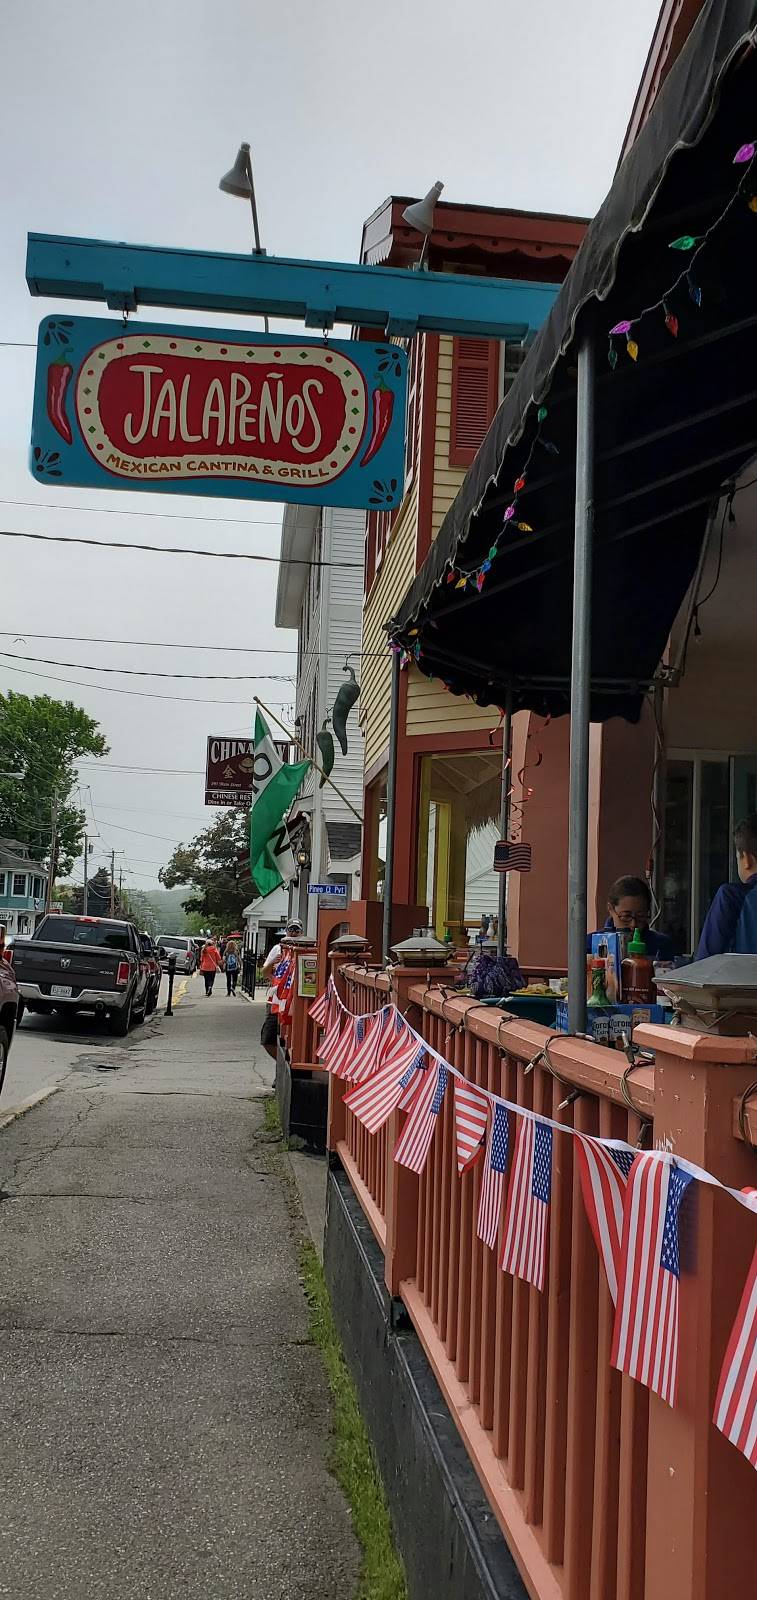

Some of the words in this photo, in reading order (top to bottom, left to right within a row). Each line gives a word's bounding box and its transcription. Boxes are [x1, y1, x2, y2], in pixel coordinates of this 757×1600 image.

[124, 365, 324, 453] JALAPEÑOS
[106, 454, 182, 474] MEXICAN
[186, 460, 259, 475] CANTINA
[262, 464, 274, 476] &
[277, 466, 330, 479] GRILL
[211, 741, 254, 764] CHINA
